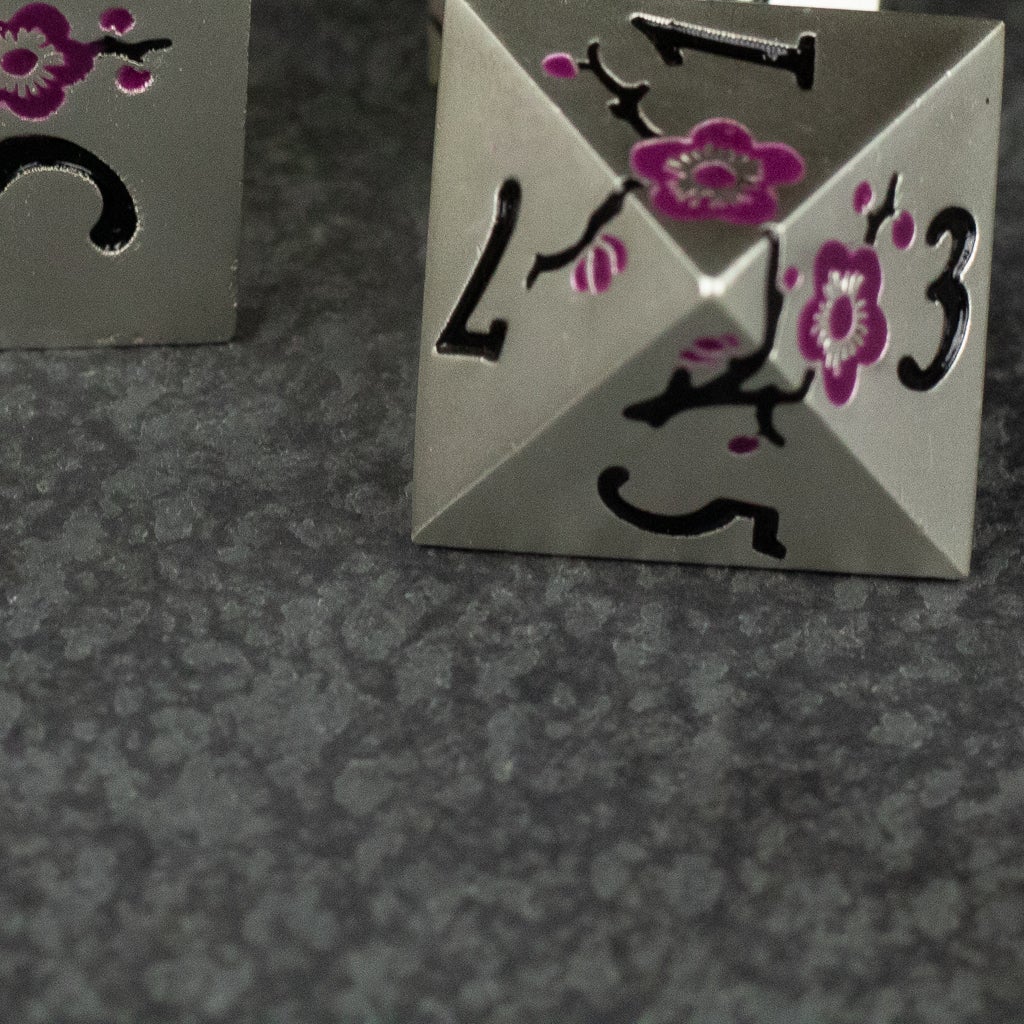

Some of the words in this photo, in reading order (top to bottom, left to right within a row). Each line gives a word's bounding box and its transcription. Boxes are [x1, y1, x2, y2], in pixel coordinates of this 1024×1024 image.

[628, 11, 817, 91] 1
[896, 205, 980, 392] 3
[596, 464, 788, 560] 5
